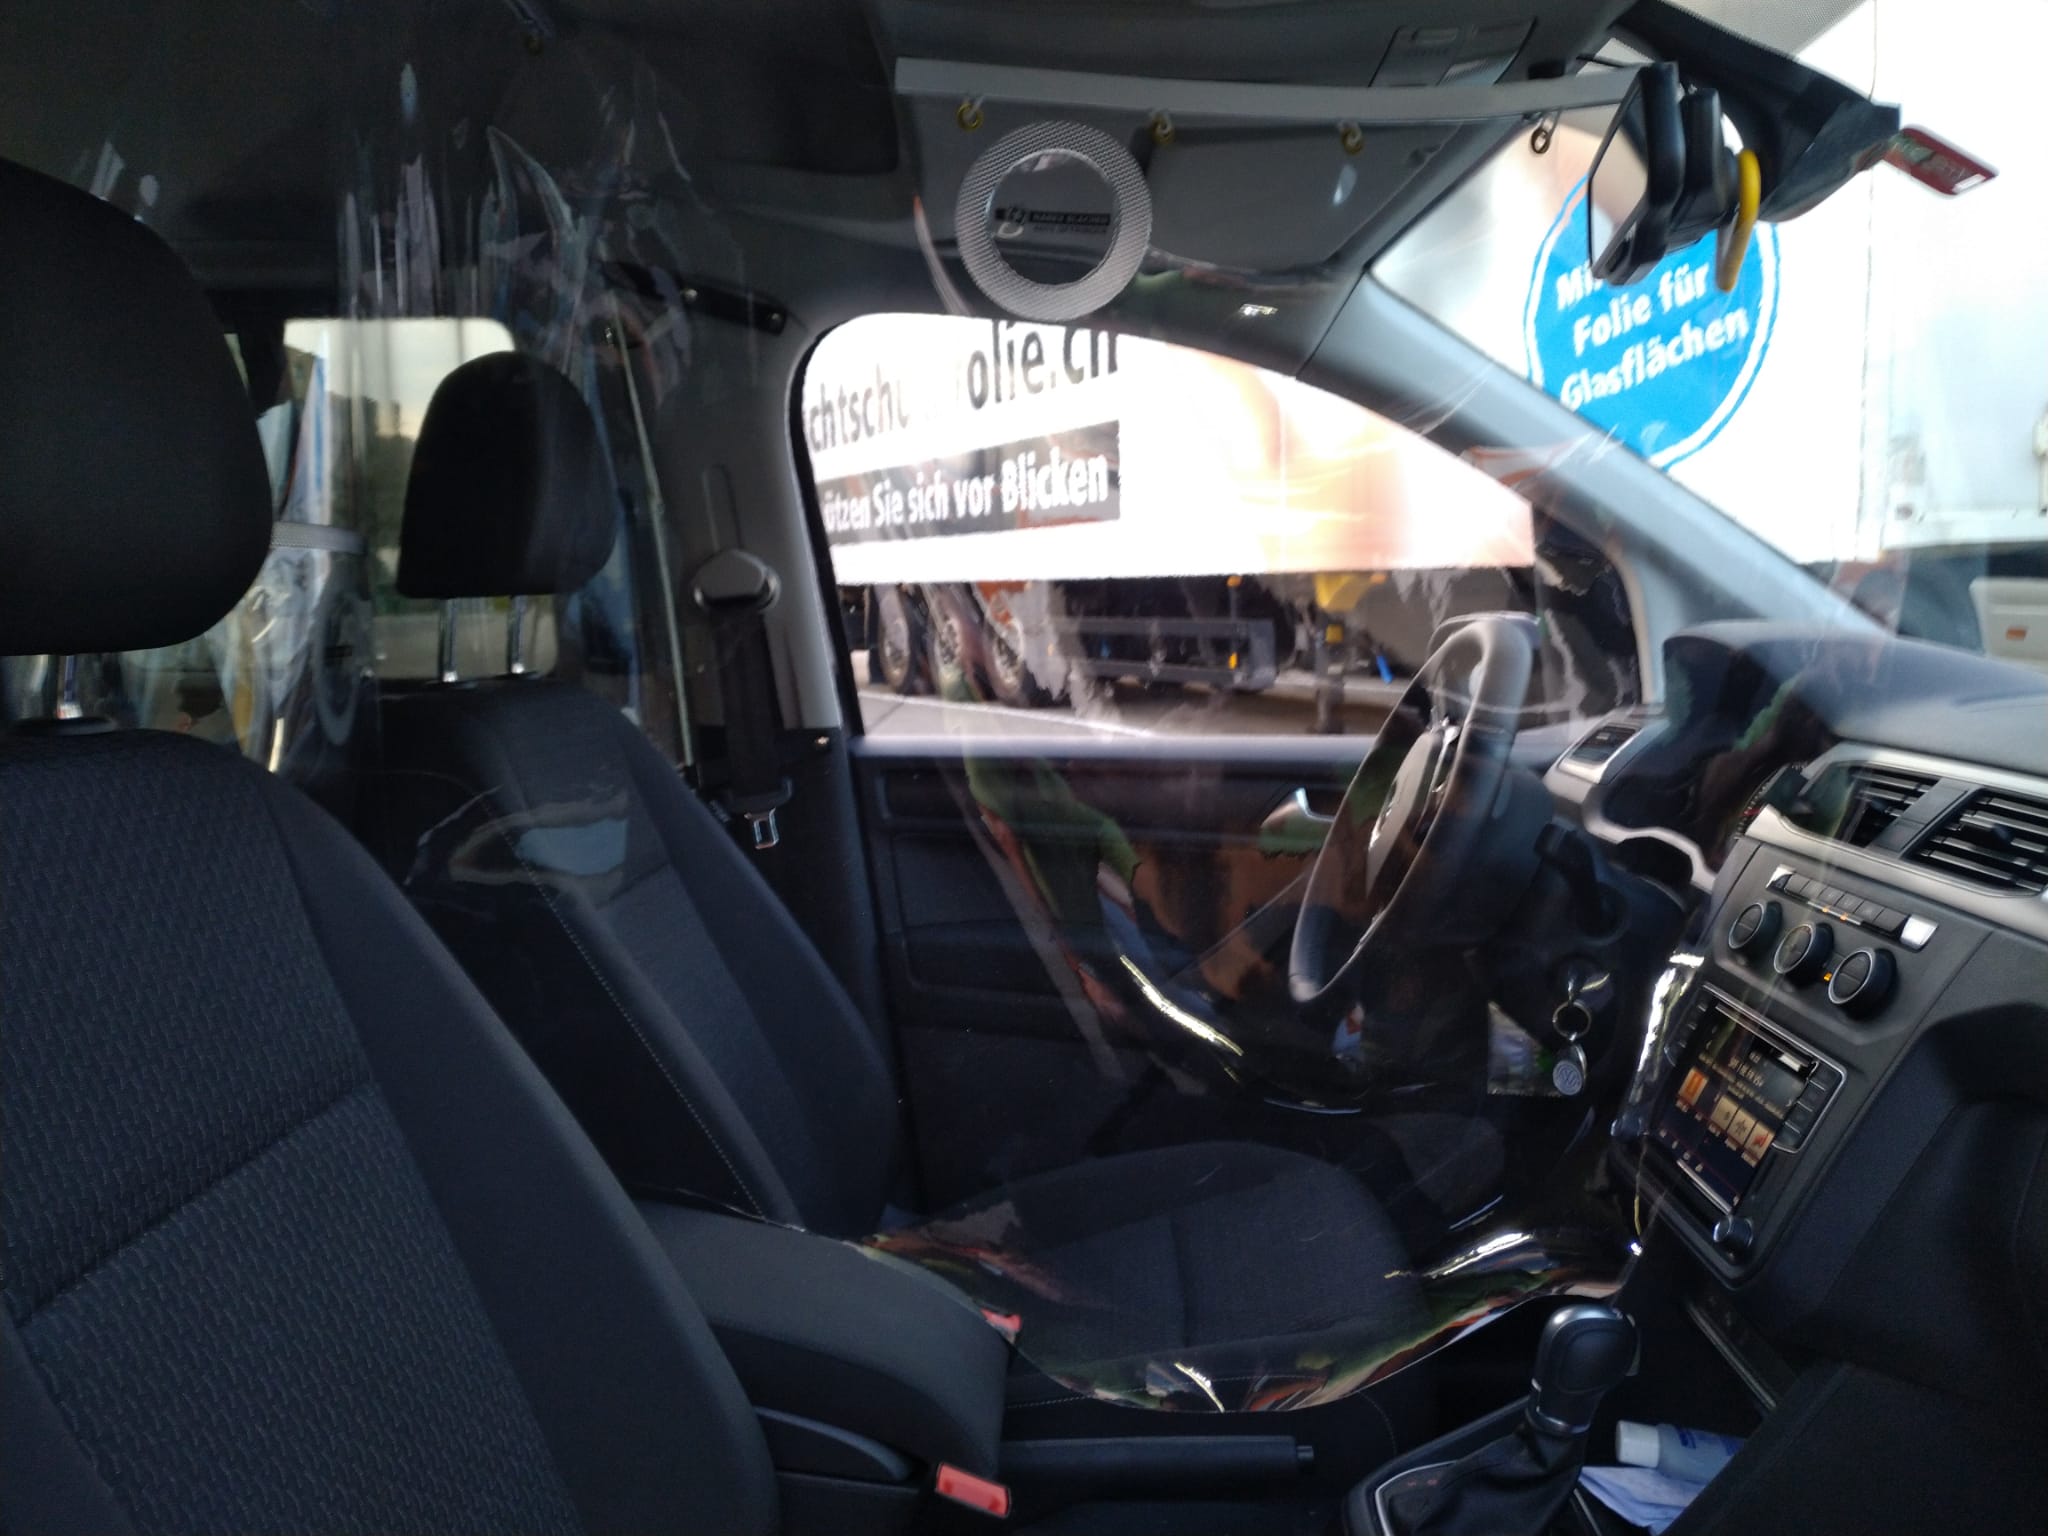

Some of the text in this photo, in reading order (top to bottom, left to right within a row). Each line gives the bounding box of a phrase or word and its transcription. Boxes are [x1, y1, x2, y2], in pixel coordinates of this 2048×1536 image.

[1556, 259, 1604, 312] Mi
[1573, 263, 1710, 358] Folie für
[1560, 306, 1750, 413] Glasflächen
[822, 445, 1109, 534] ützen Sie sich vor Blicken
